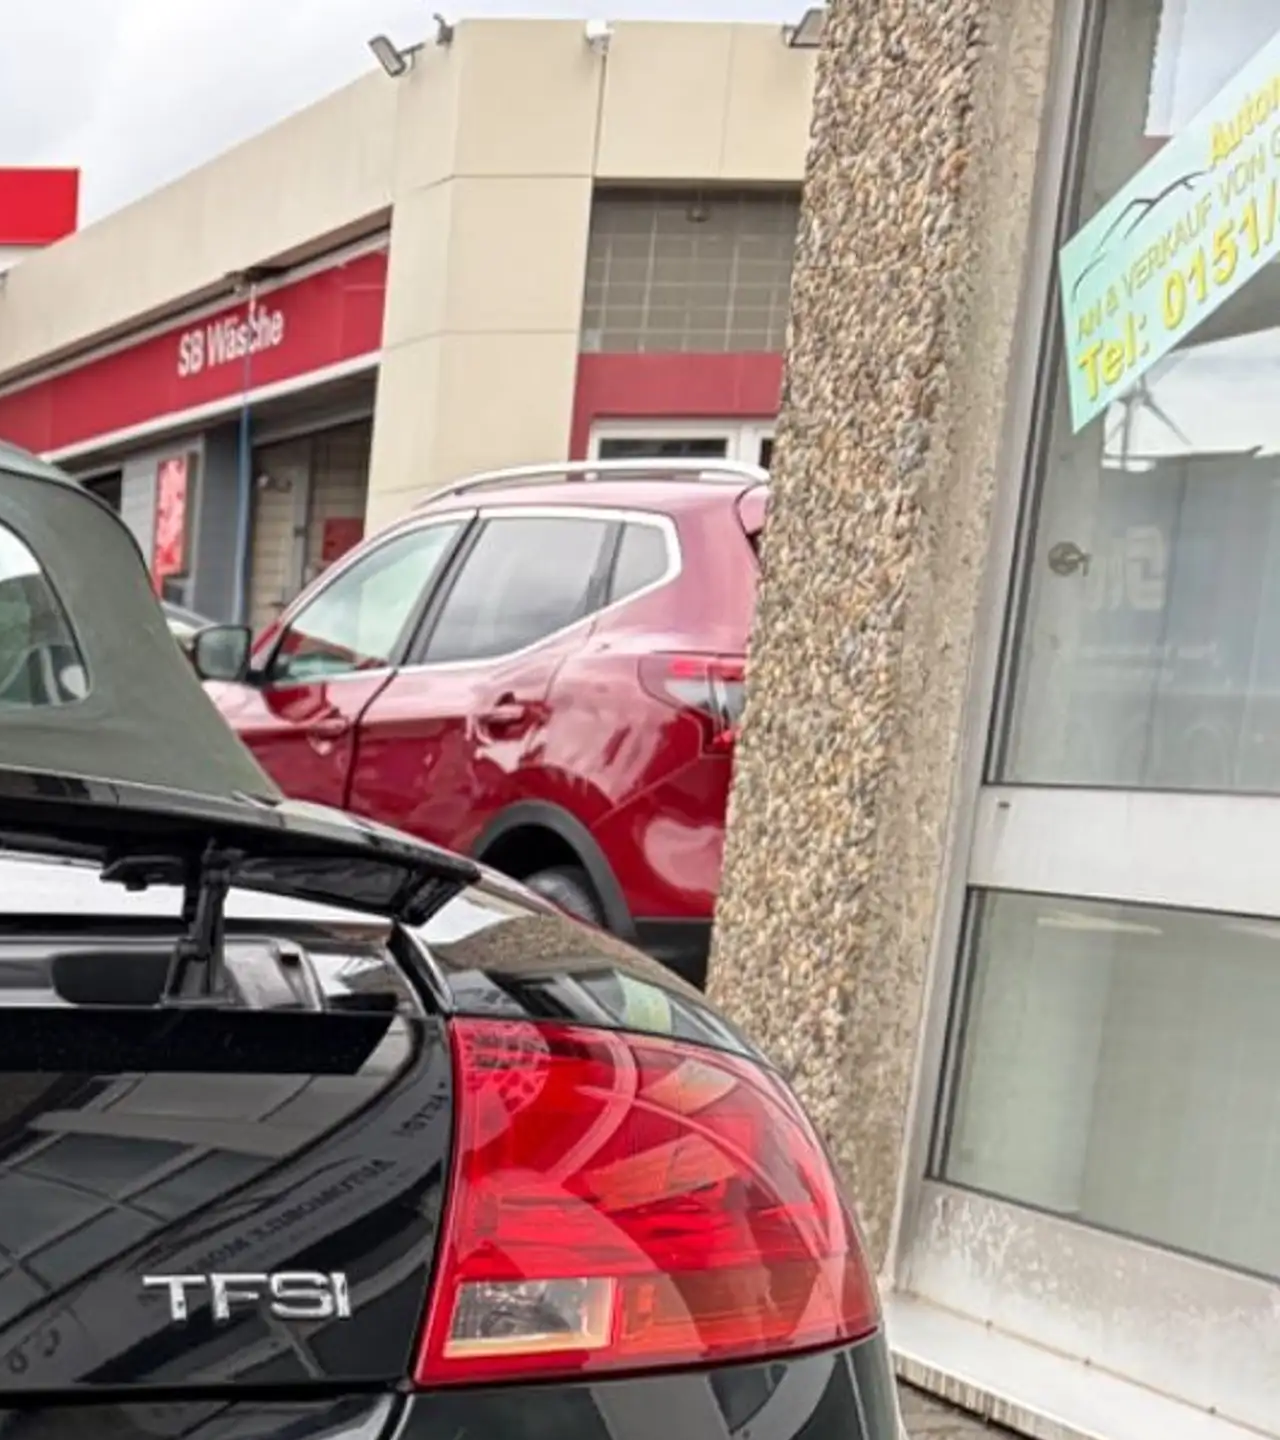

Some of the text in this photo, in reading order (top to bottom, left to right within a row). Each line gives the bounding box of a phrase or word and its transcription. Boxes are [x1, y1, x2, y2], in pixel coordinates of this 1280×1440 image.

[1121, 191, 1212, 298] VERKAUF
[1219, 142, 1266, 207] VON
[177, 304, 284, 377] SB Wäsche
[1077, 312, 1150, 402] Tel:
[142, 1272, 351, 1322] TFSI
